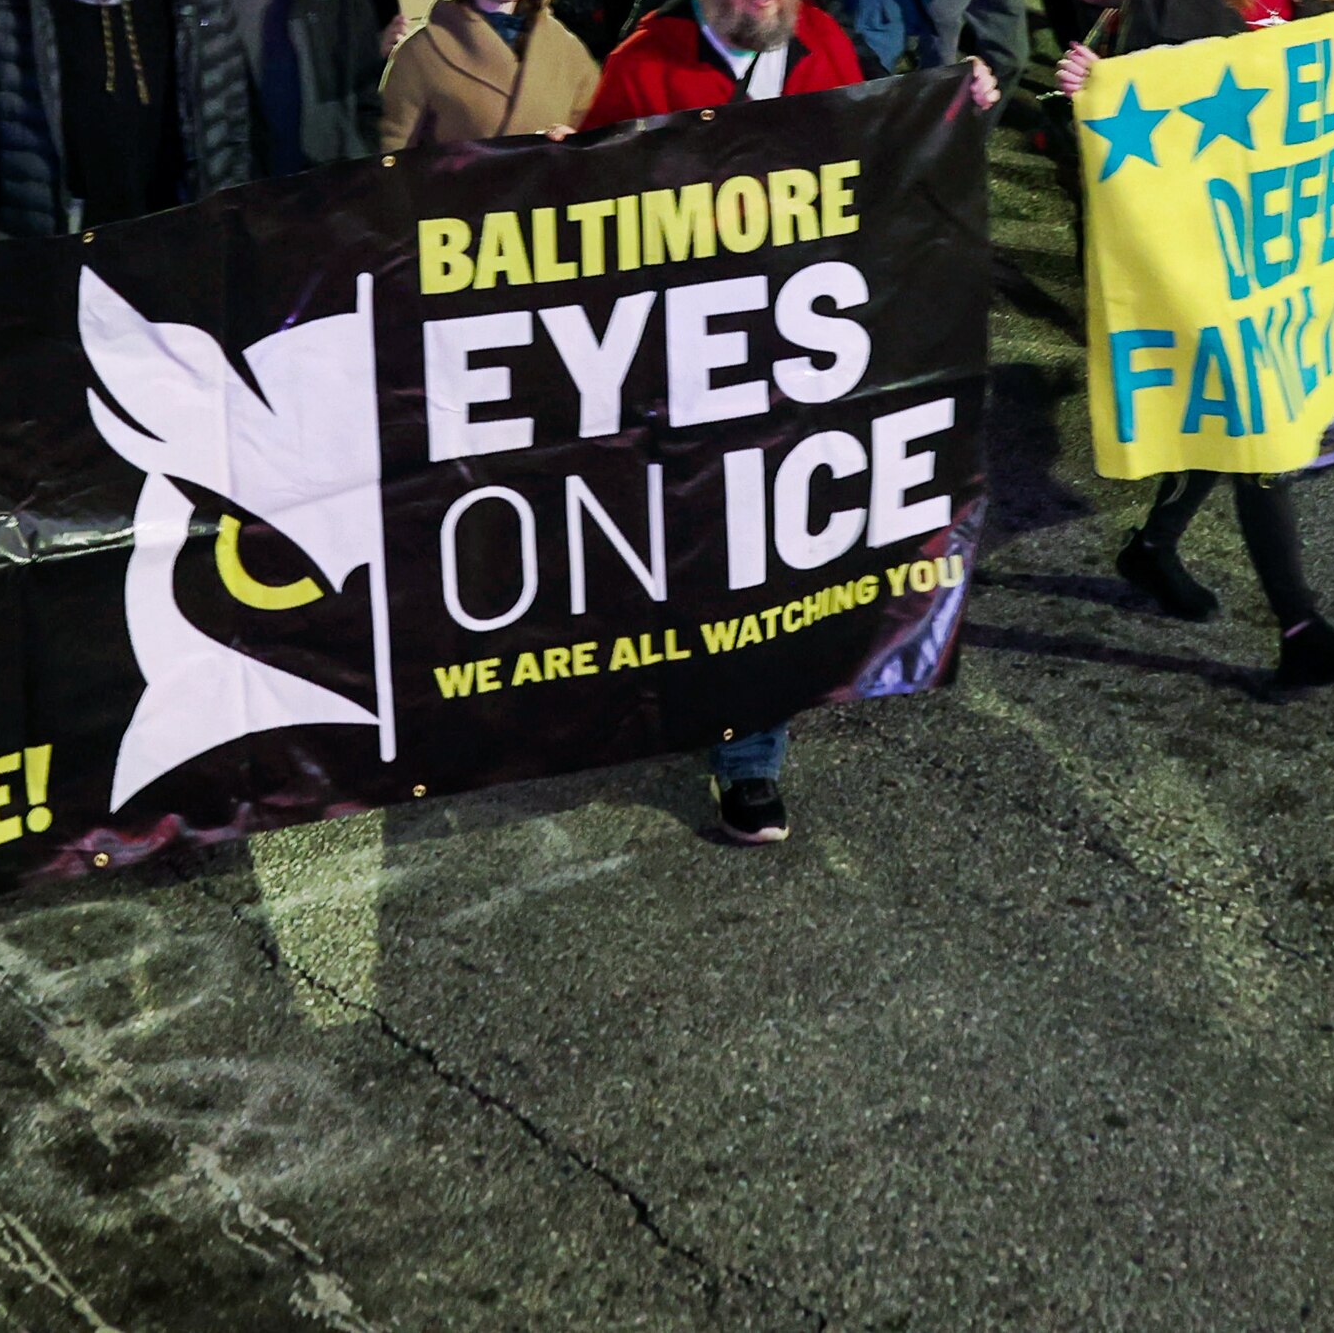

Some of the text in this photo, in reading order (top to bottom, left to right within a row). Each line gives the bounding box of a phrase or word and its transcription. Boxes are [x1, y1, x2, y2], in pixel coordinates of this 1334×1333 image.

[417, 160, 861, 296] BALTIMORE
[423, 261, 872, 462] EYES
[440, 397, 956, 632] ON ICE
[434, 554, 965, 699] WE ARE ALL WATCHING YOU
